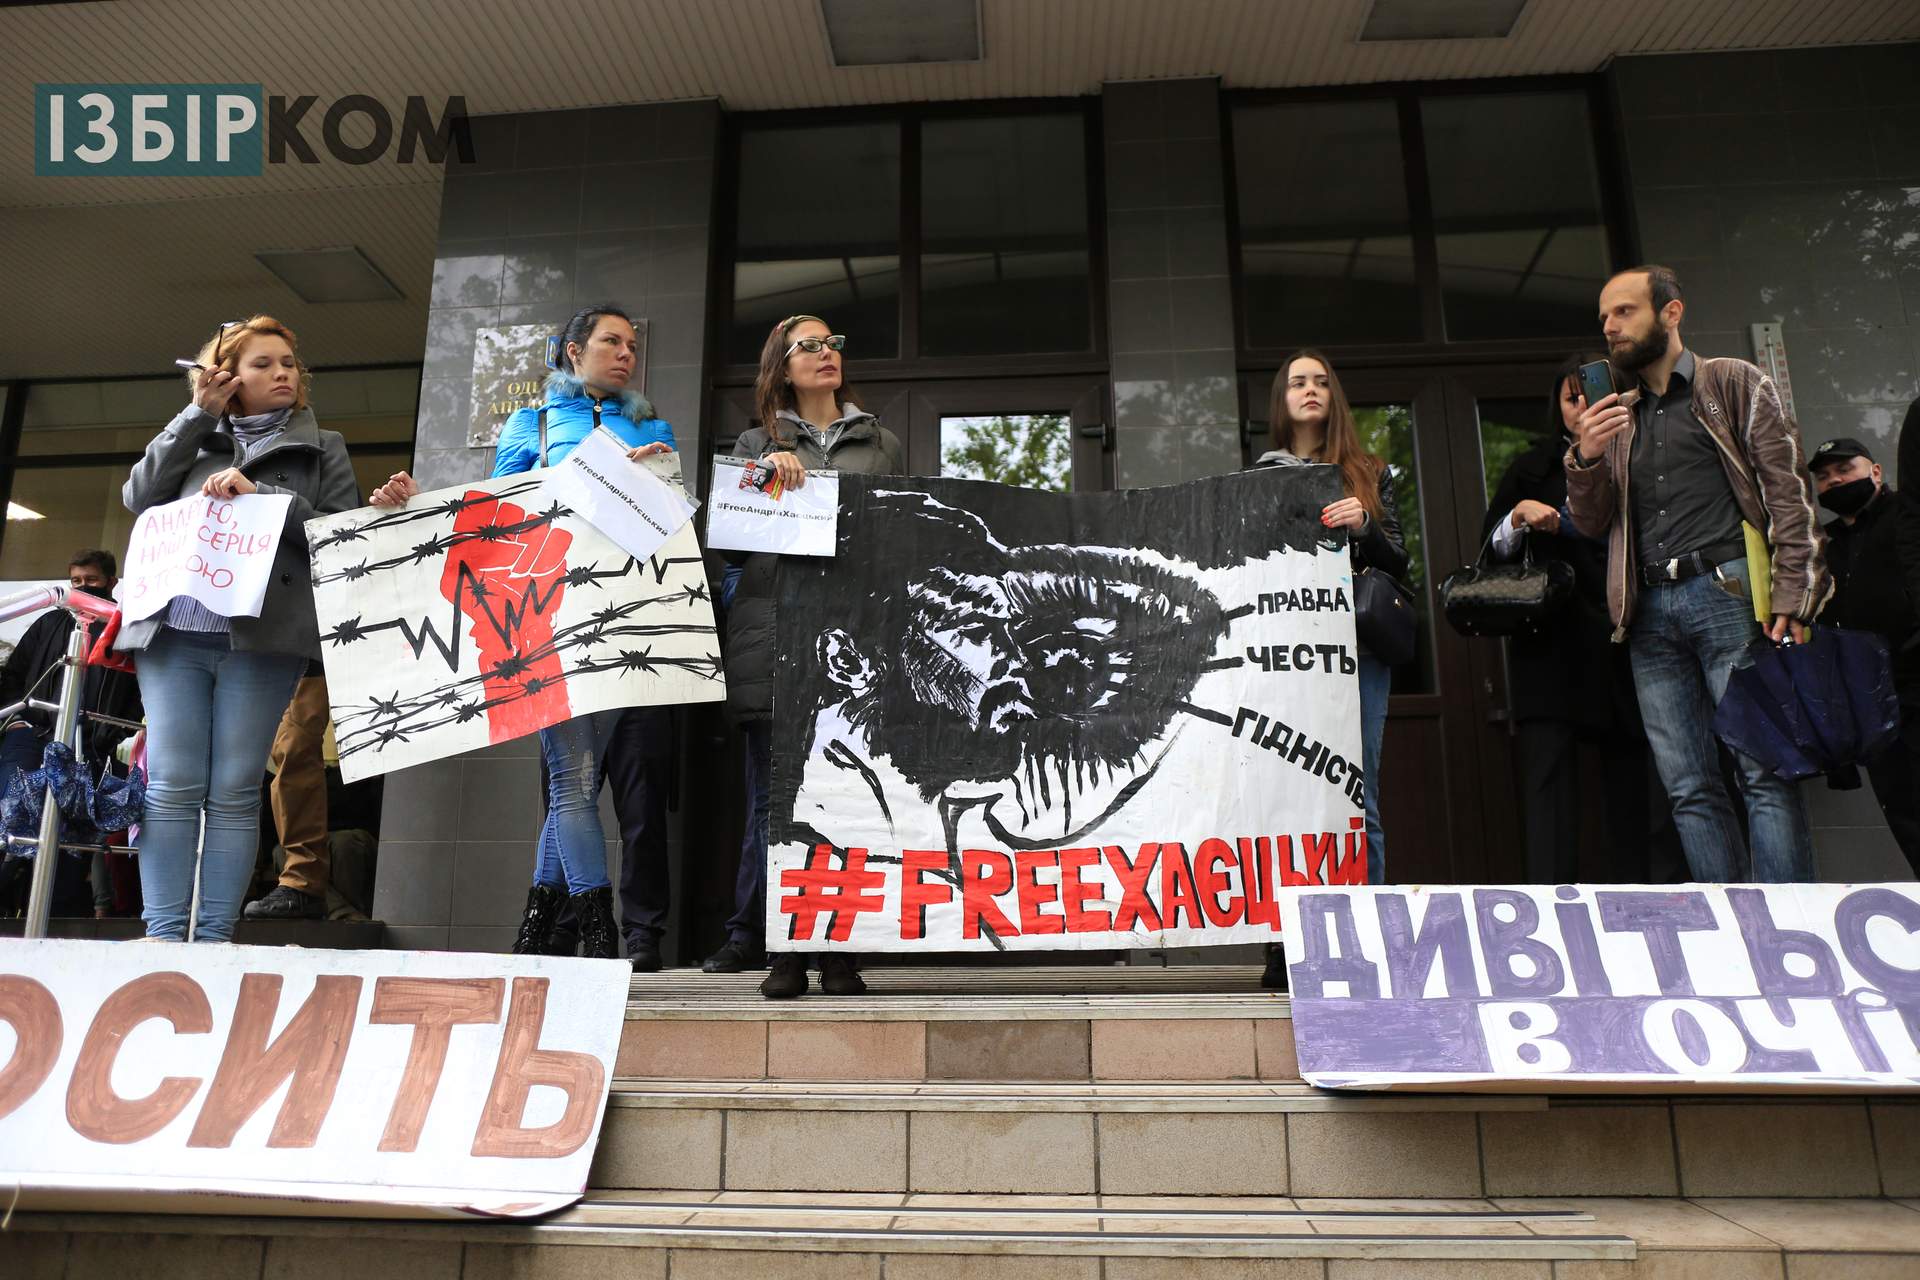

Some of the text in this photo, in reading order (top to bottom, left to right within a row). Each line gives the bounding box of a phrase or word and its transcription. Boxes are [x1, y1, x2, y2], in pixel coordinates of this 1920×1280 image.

[572, 456, 669, 537] #FreeАндрійХаєцький
[197, 525, 271, 555] СЕРЦЯ
[1258, 587, 1350, 615] ПРАВДА
[1247, 643, 1356, 674] ЧЕСТЬ
[1231, 706, 1366, 810] ГІДНІСТЬ
